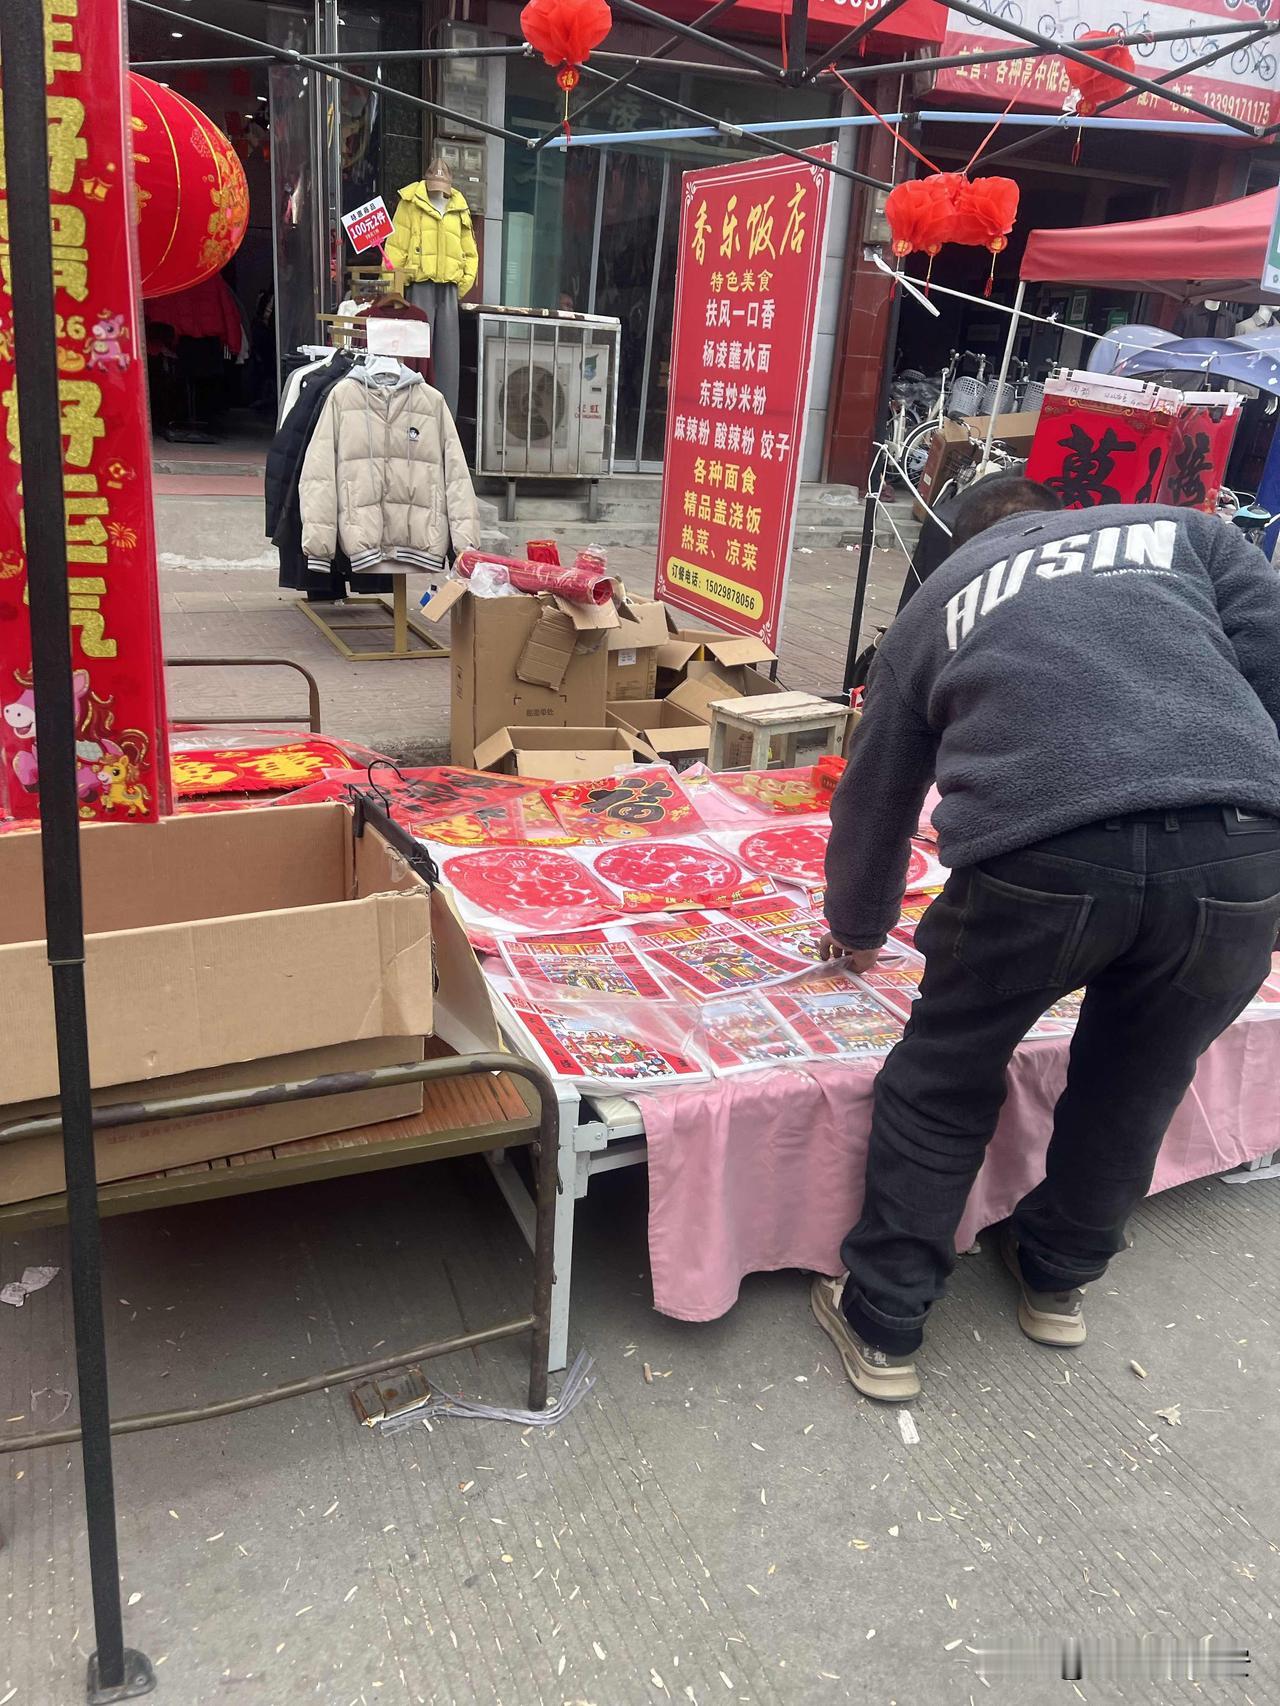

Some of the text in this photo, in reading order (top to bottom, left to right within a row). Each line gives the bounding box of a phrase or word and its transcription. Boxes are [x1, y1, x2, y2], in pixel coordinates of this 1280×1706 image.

[349, 210, 386, 240] 100元2件
[692, 182, 807, 266] 香乐饭店
[710, 269, 774, 293] 特色美食
[705, 298, 776, 330] 扶风一口香
[702, 338, 772, 373] 杨凌蘸水面
[699, 378, 767, 416] 东莞炒米粉
[673, 413, 791, 463] 麻辣粉 酸辣粉 饺子
[693, 456, 758, 496] 各种面食
[683, 490, 763, 536] 精品盖浇饭
[680, 524, 759, 572] 热菜、凉菜
[704, 578, 756, 612] 15029878056
[944, 519, 1178, 651] AUSIN
